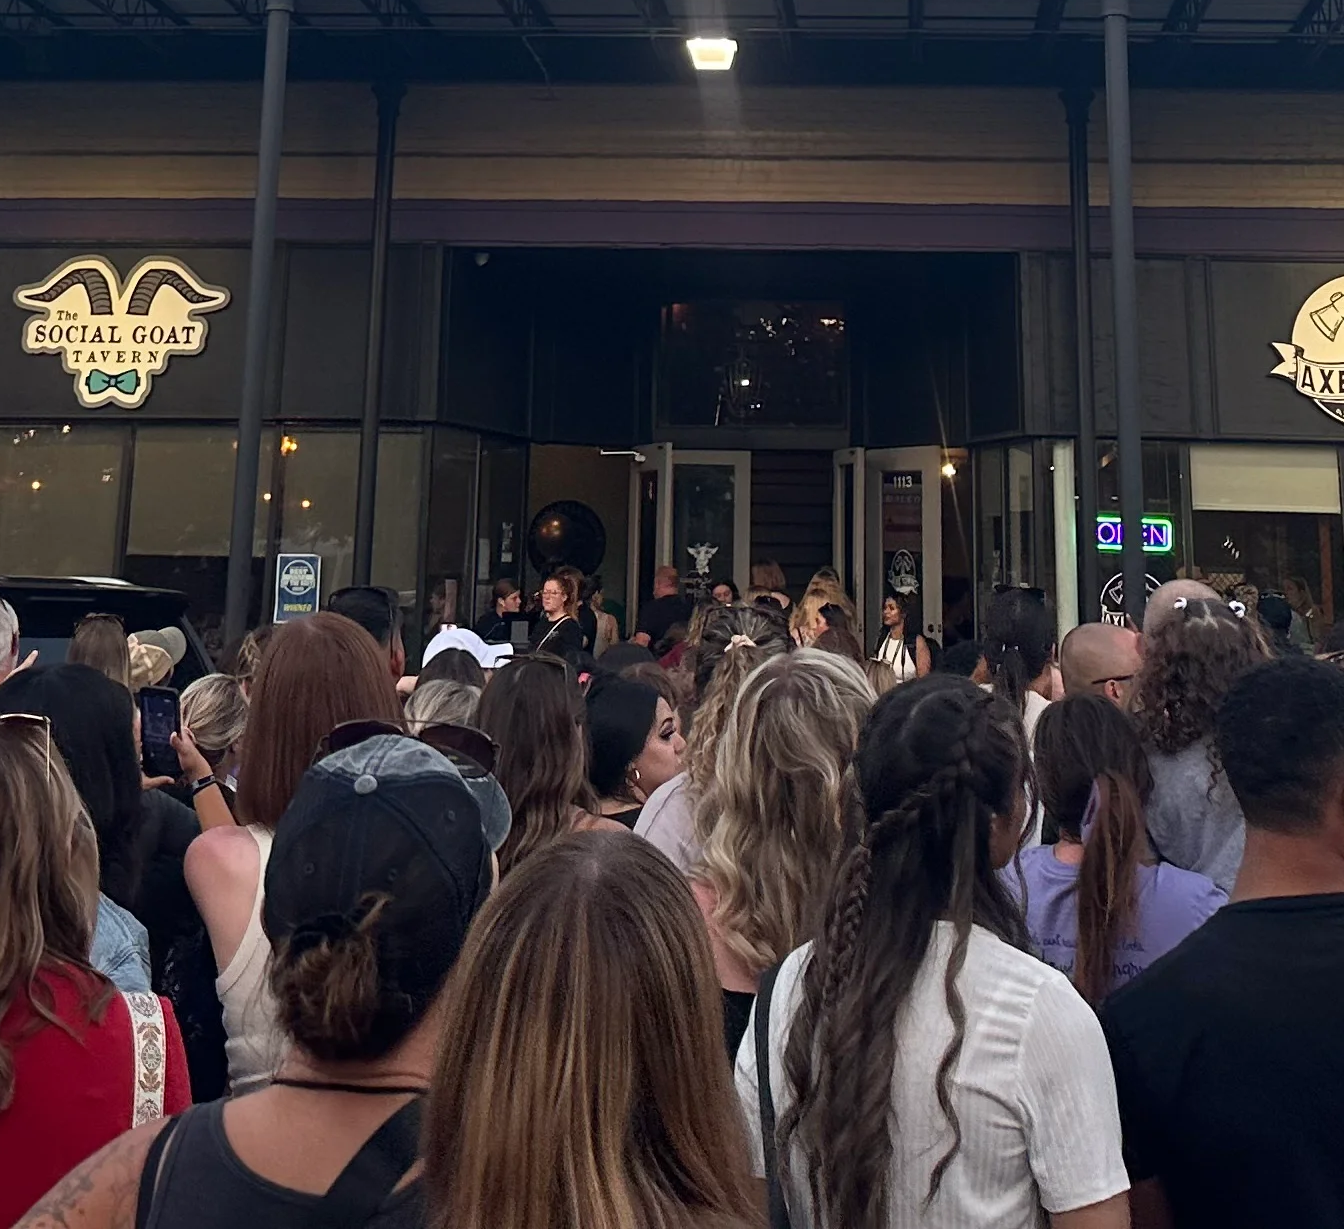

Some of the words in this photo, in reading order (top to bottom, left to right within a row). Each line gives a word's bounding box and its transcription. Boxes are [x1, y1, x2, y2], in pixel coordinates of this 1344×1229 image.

[57, 310, 78, 320] The
[35, 324, 122, 344] SOCIAL
[132, 325, 196, 344] GOAT
[72, 350, 159, 363] TAVERN
[893, 475, 912, 489] 1113
[1097, 522, 1167, 545] ON
